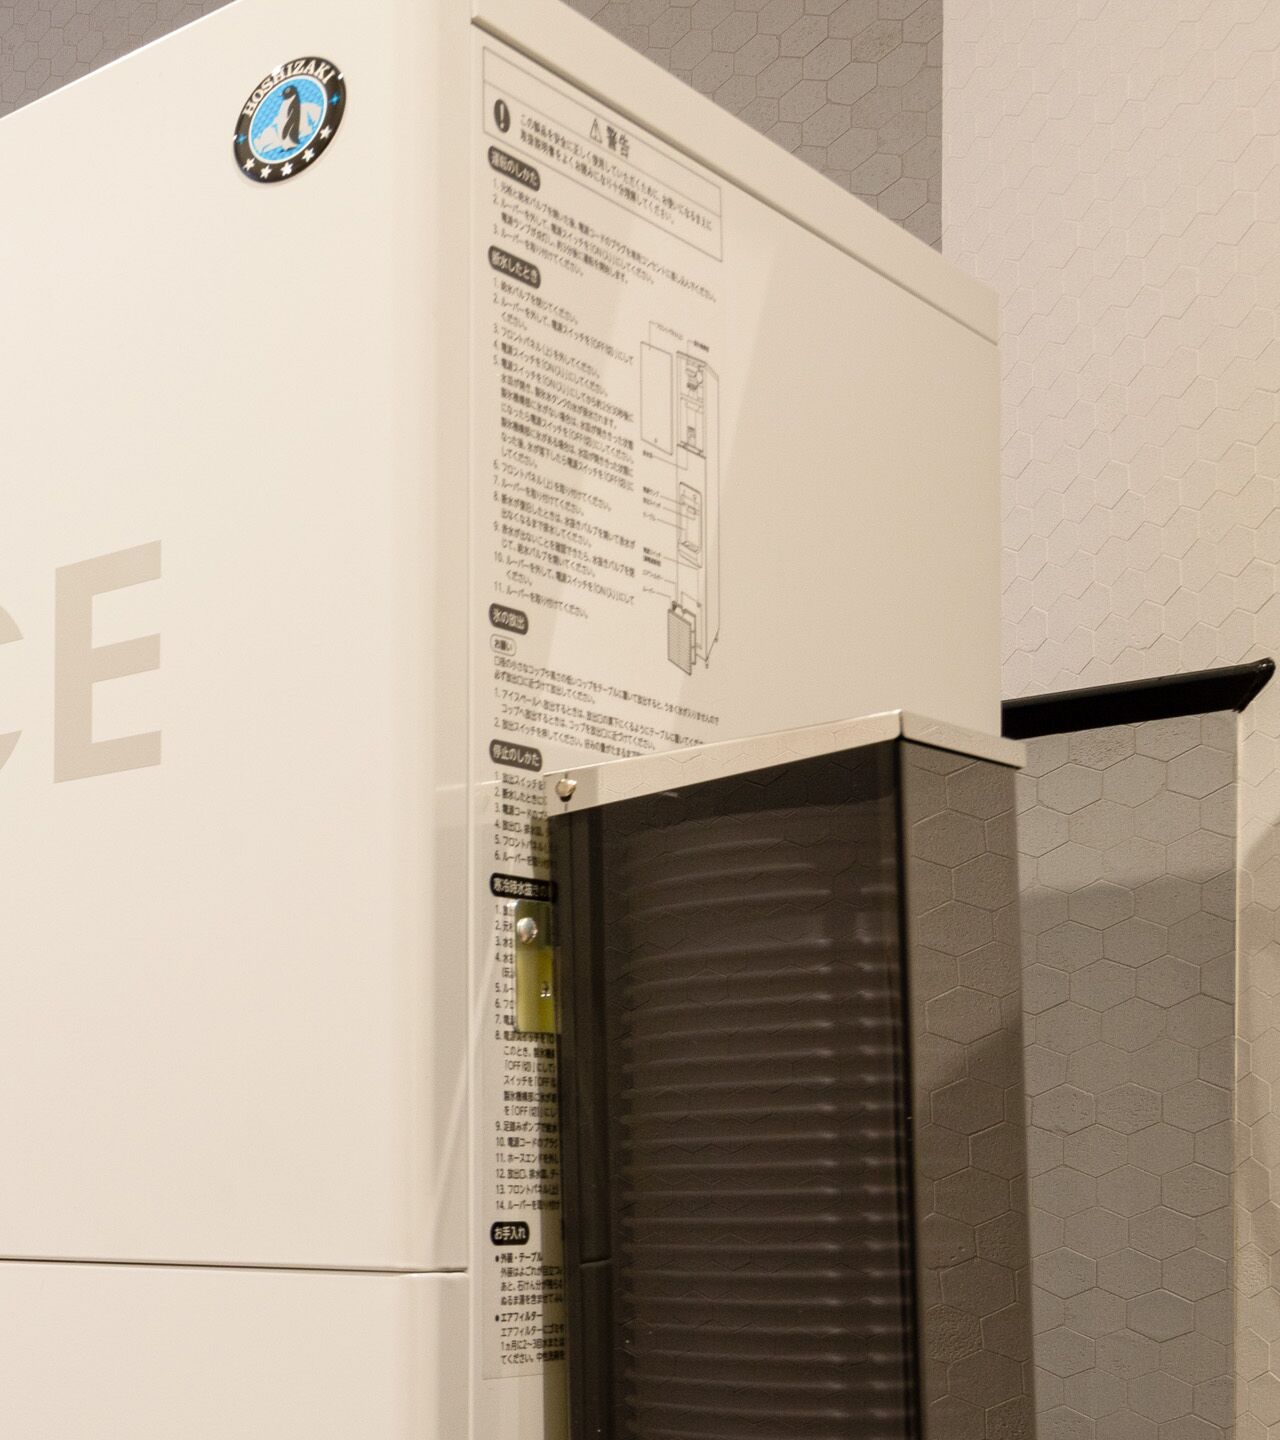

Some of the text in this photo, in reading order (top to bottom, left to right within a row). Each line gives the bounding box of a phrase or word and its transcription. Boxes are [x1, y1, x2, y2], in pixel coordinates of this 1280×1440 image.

[242, 59, 336, 117] HOSHIZAKI
[606, 126, 629, 161] 警告
[501, 309, 527, 331] ください。
[501, 444, 537, 470] してください。
[506, 568, 532, 586] ください。
[493, 745, 539, 767] 停止のしかた
[495, 1226, 526, 1240] お手入れ
[501, 1311, 543, 1322] エアフィルター
